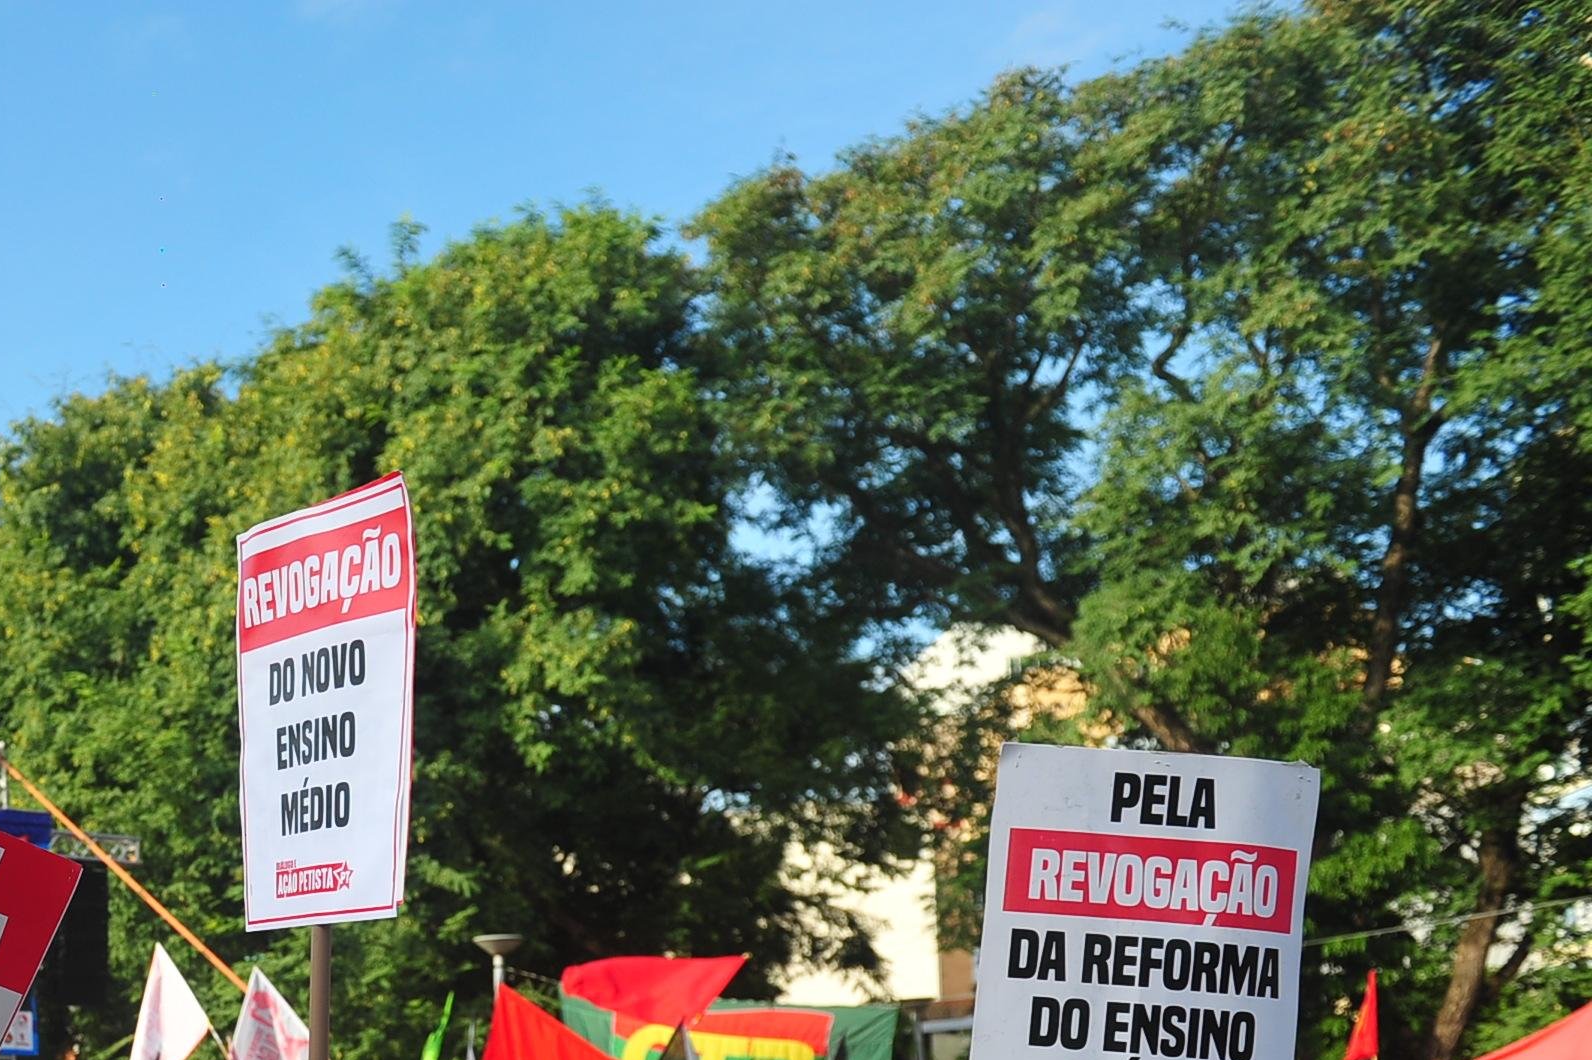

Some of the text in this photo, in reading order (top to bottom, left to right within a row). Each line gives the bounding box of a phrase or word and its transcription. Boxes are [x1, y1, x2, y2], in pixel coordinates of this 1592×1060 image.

[242, 524, 403, 631] REVOGAÇÃO
[269, 639, 366, 706] DO NOVO
[276, 711, 356, 770] ENSINO
[281, 777, 350, 836] MÉDIO
[1110, 772, 1216, 829] PELA
[277, 869, 297, 897] AÇÃO
[298, 867, 334, 891] PETISTA
[1028, 848, 1279, 927] REVOGAÇÃO
[1007, 928, 1279, 1000] DA REFORMA
[1028, 997, 1090, 1050] DO
